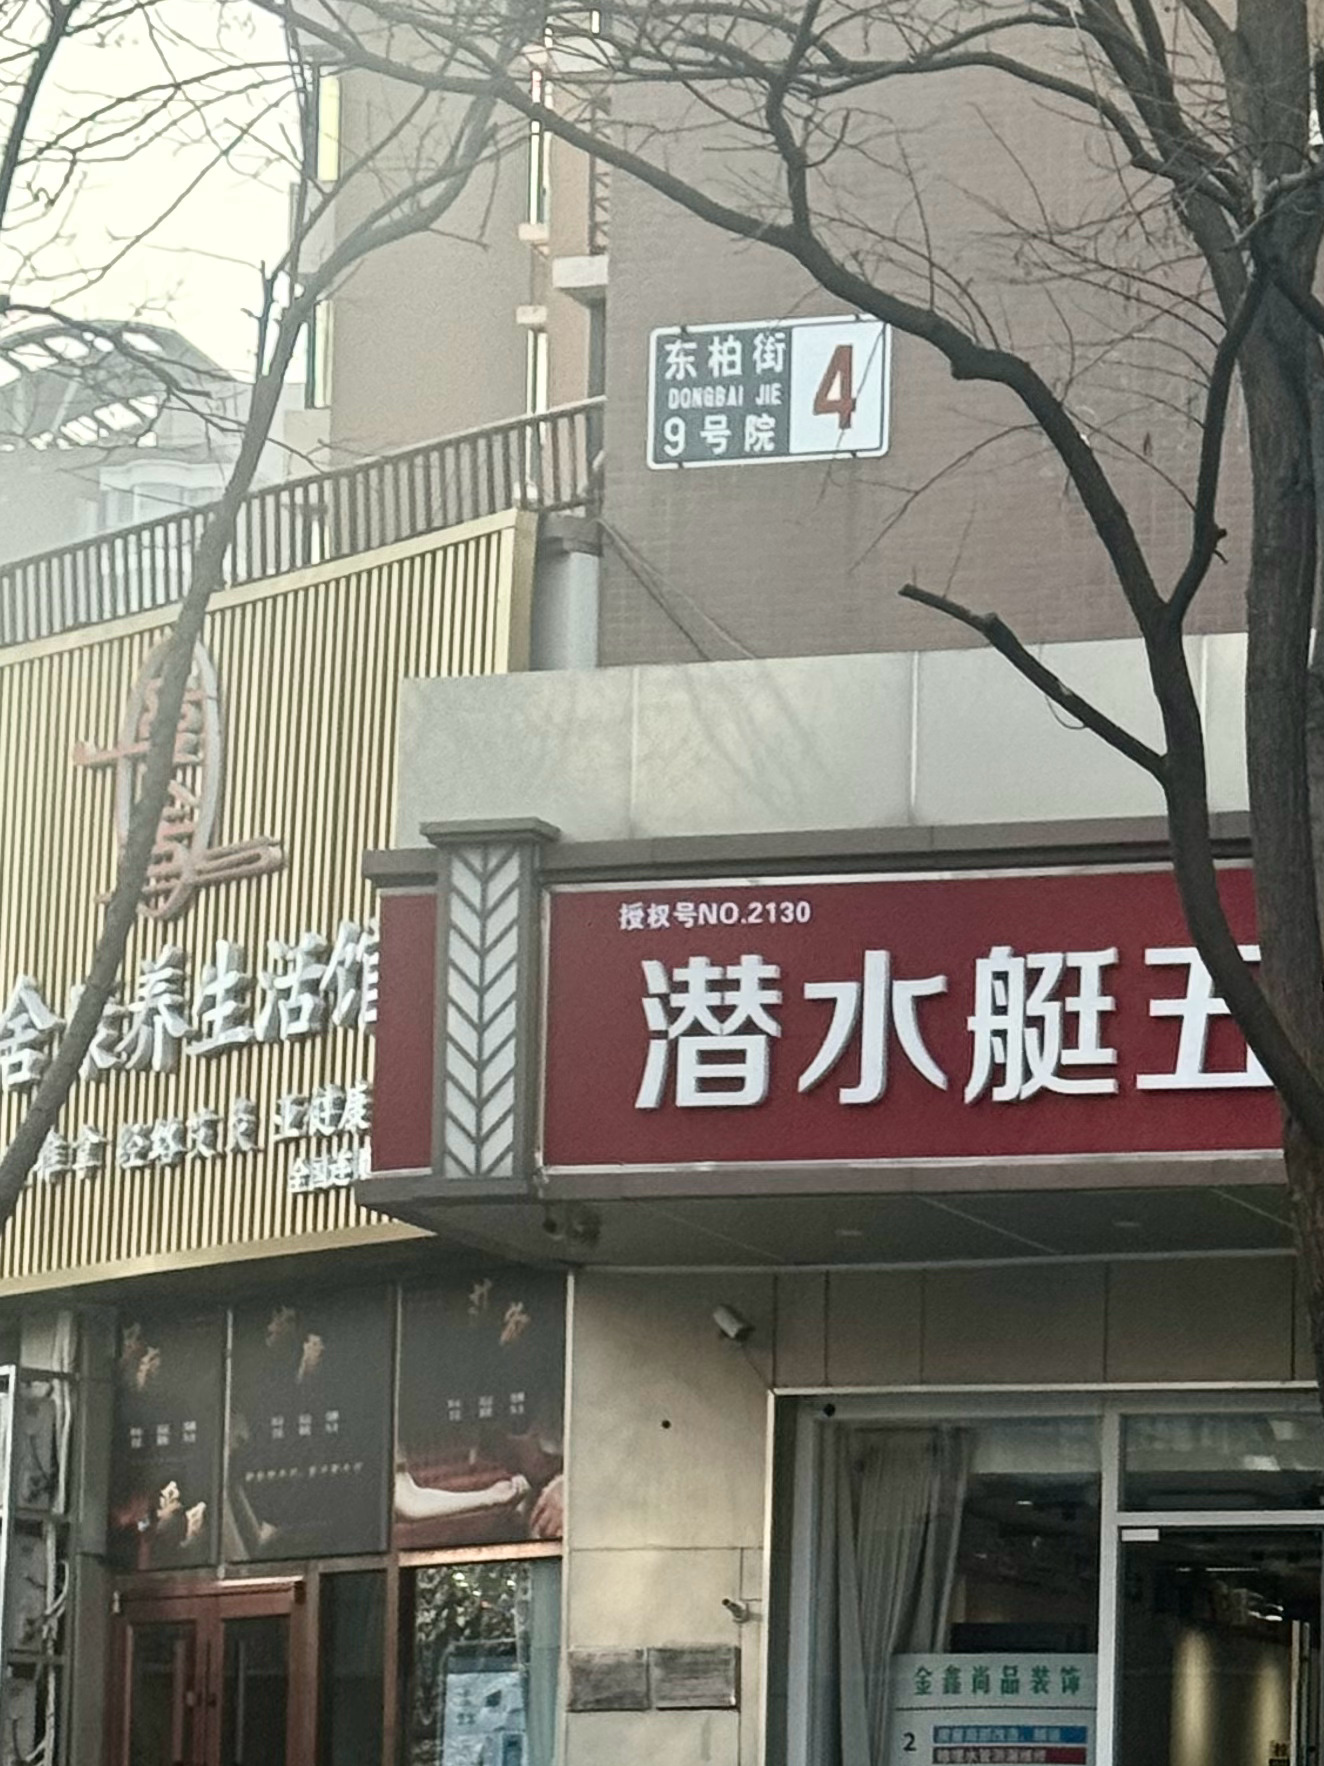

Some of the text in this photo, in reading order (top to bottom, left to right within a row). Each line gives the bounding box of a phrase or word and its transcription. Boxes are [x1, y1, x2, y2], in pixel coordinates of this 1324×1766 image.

[664, 332, 787, 380] 东柏街
[667, 384, 783, 411] DONGBAI JIE
[813, 345, 856, 430] 4
[663, 413, 776, 457] 9号院
[619, 900, 811, 930] 授权号NO.2130
[914, 1664, 1081, 1696] 金鑫尚品装饰
